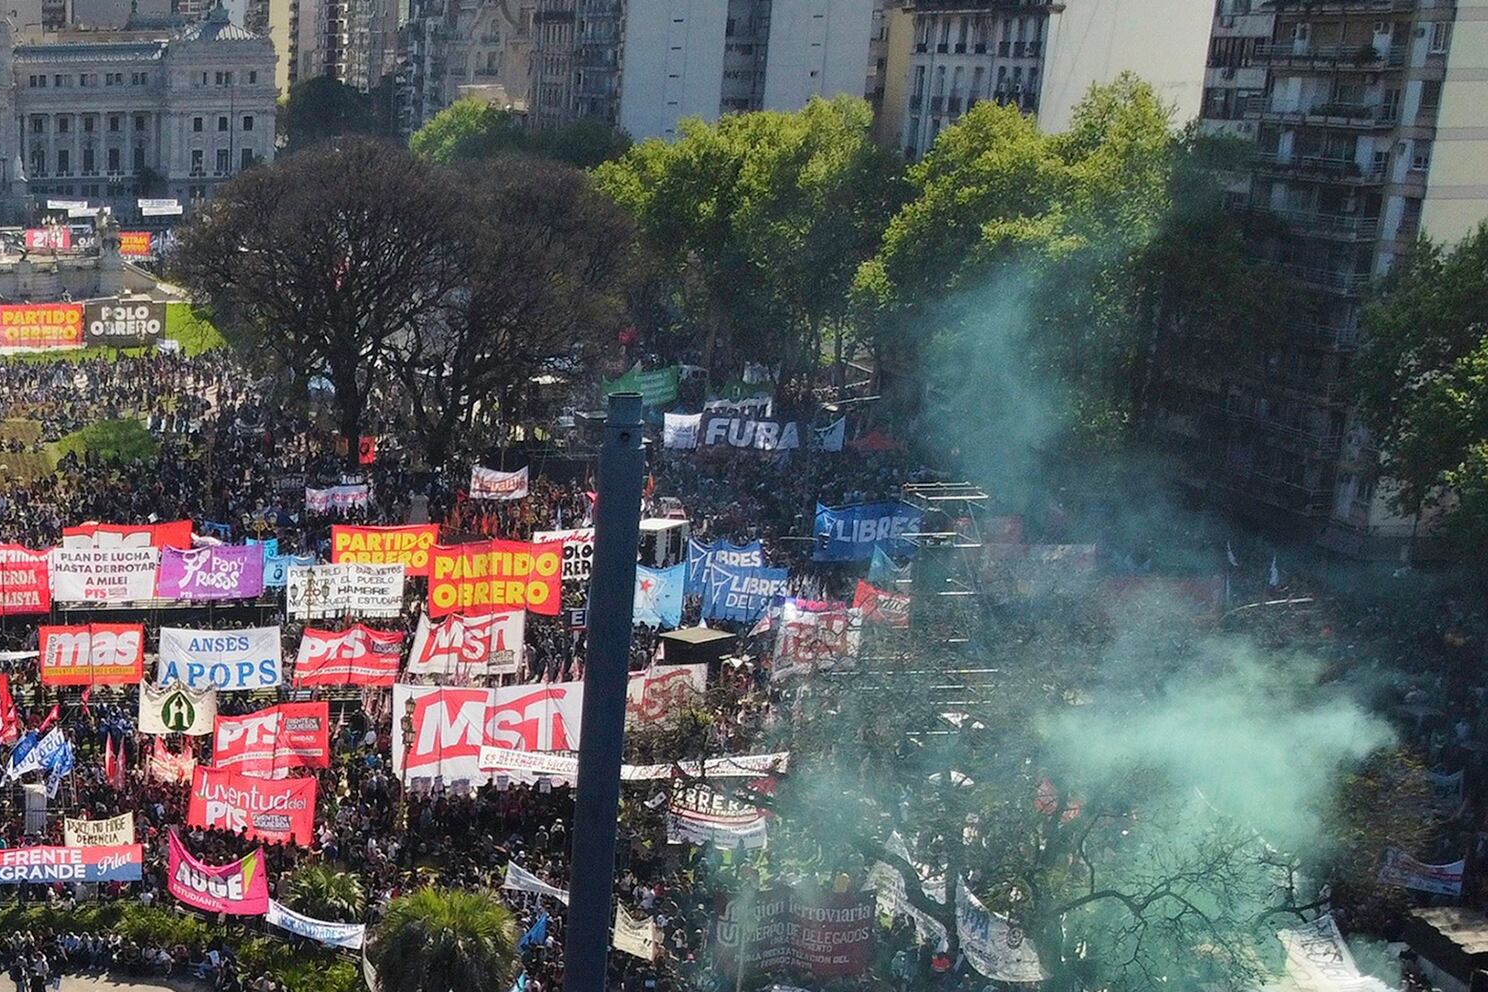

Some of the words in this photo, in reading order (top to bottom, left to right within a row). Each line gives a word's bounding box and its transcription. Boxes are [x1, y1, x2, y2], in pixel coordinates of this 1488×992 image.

[2, 309, 82, 326] PARTIDO
[101, 306, 151, 321] POLO
[5, 325, 77, 341] OBRERO
[90, 317, 161, 338] OBRERO
[704, 417, 800, 450] FUBA
[836, 515, 922, 543] LIBRES
[336, 532, 434, 552] PARTIDO
[61, 552, 91, 562] PLAN
[93, 552, 109, 562] DE
[110, 551, 151, 562] LUCHA
[434, 552, 558, 579] PARTIDO
[55, 563, 93, 574] HASTA
[94, 562, 155, 573] DERROTAR
[86, 577, 95, 586] A
[96, 576, 128, 586] MILEI
[337, 585, 390, 595] HAMBRE
[357, 576, 395, 585] PUEBLO
[729, 575, 787, 597] LIBRES
[84, 588, 107, 599] PTS
[433, 581, 549, 608] OBRERO
[725, 593, 756, 610] DEL
[52, 631, 140, 667] mas
[188, 636, 250, 652] ANSES
[297, 632, 366, 664] PTS
[162, 659, 277, 688] APOPS
[216, 712, 284, 751] PTS
[195, 771, 290, 811] Juventud
[289, 796, 307, 810] del
[206, 801, 248, 834] PTS
[2, 851, 82, 867] FRENTE
[0, 864, 86, 880] GRANDE
[175, 860, 244, 901] AUGE
[802, 927, 870, 945] DELEGADOS
